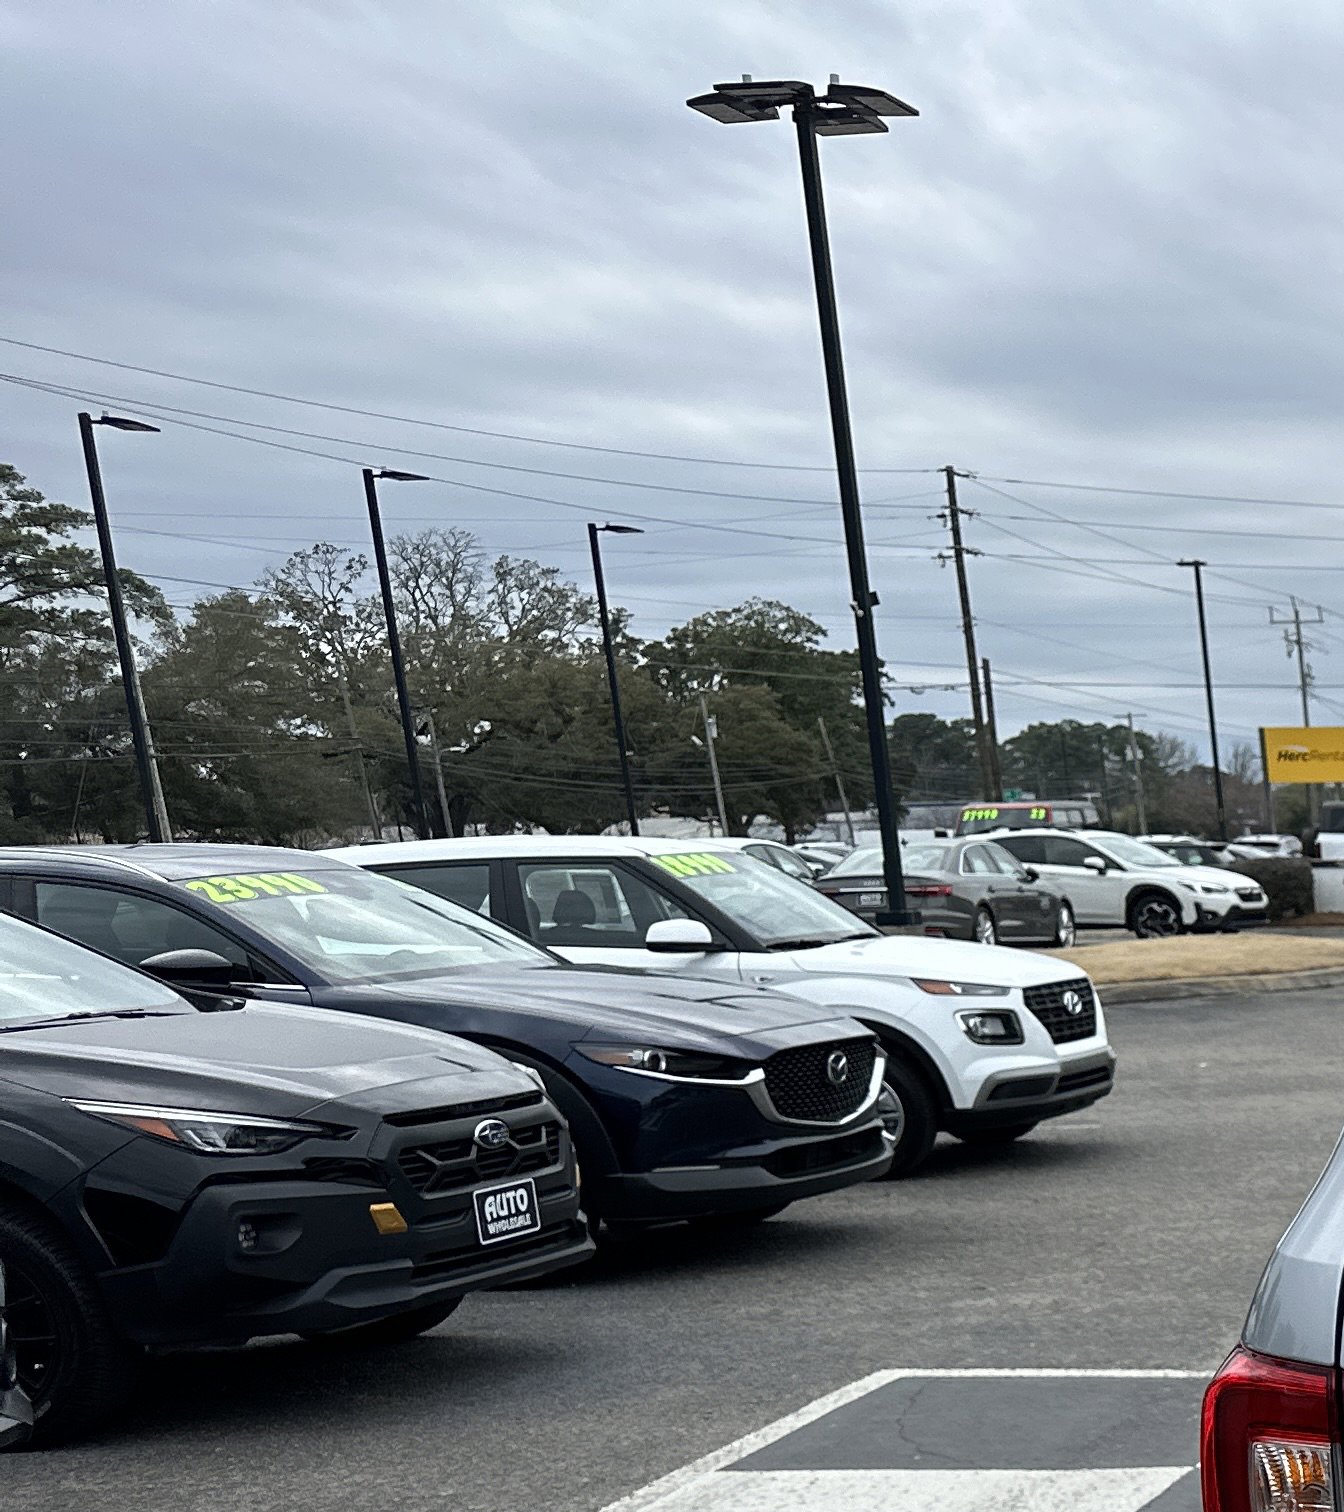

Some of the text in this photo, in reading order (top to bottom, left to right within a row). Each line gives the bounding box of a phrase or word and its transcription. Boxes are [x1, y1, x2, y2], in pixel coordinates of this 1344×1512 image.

[185, 872, 329, 903] 23990
[484, 1187, 529, 1222] AUTO
[487, 1213, 532, 1235] WHOLESALE
